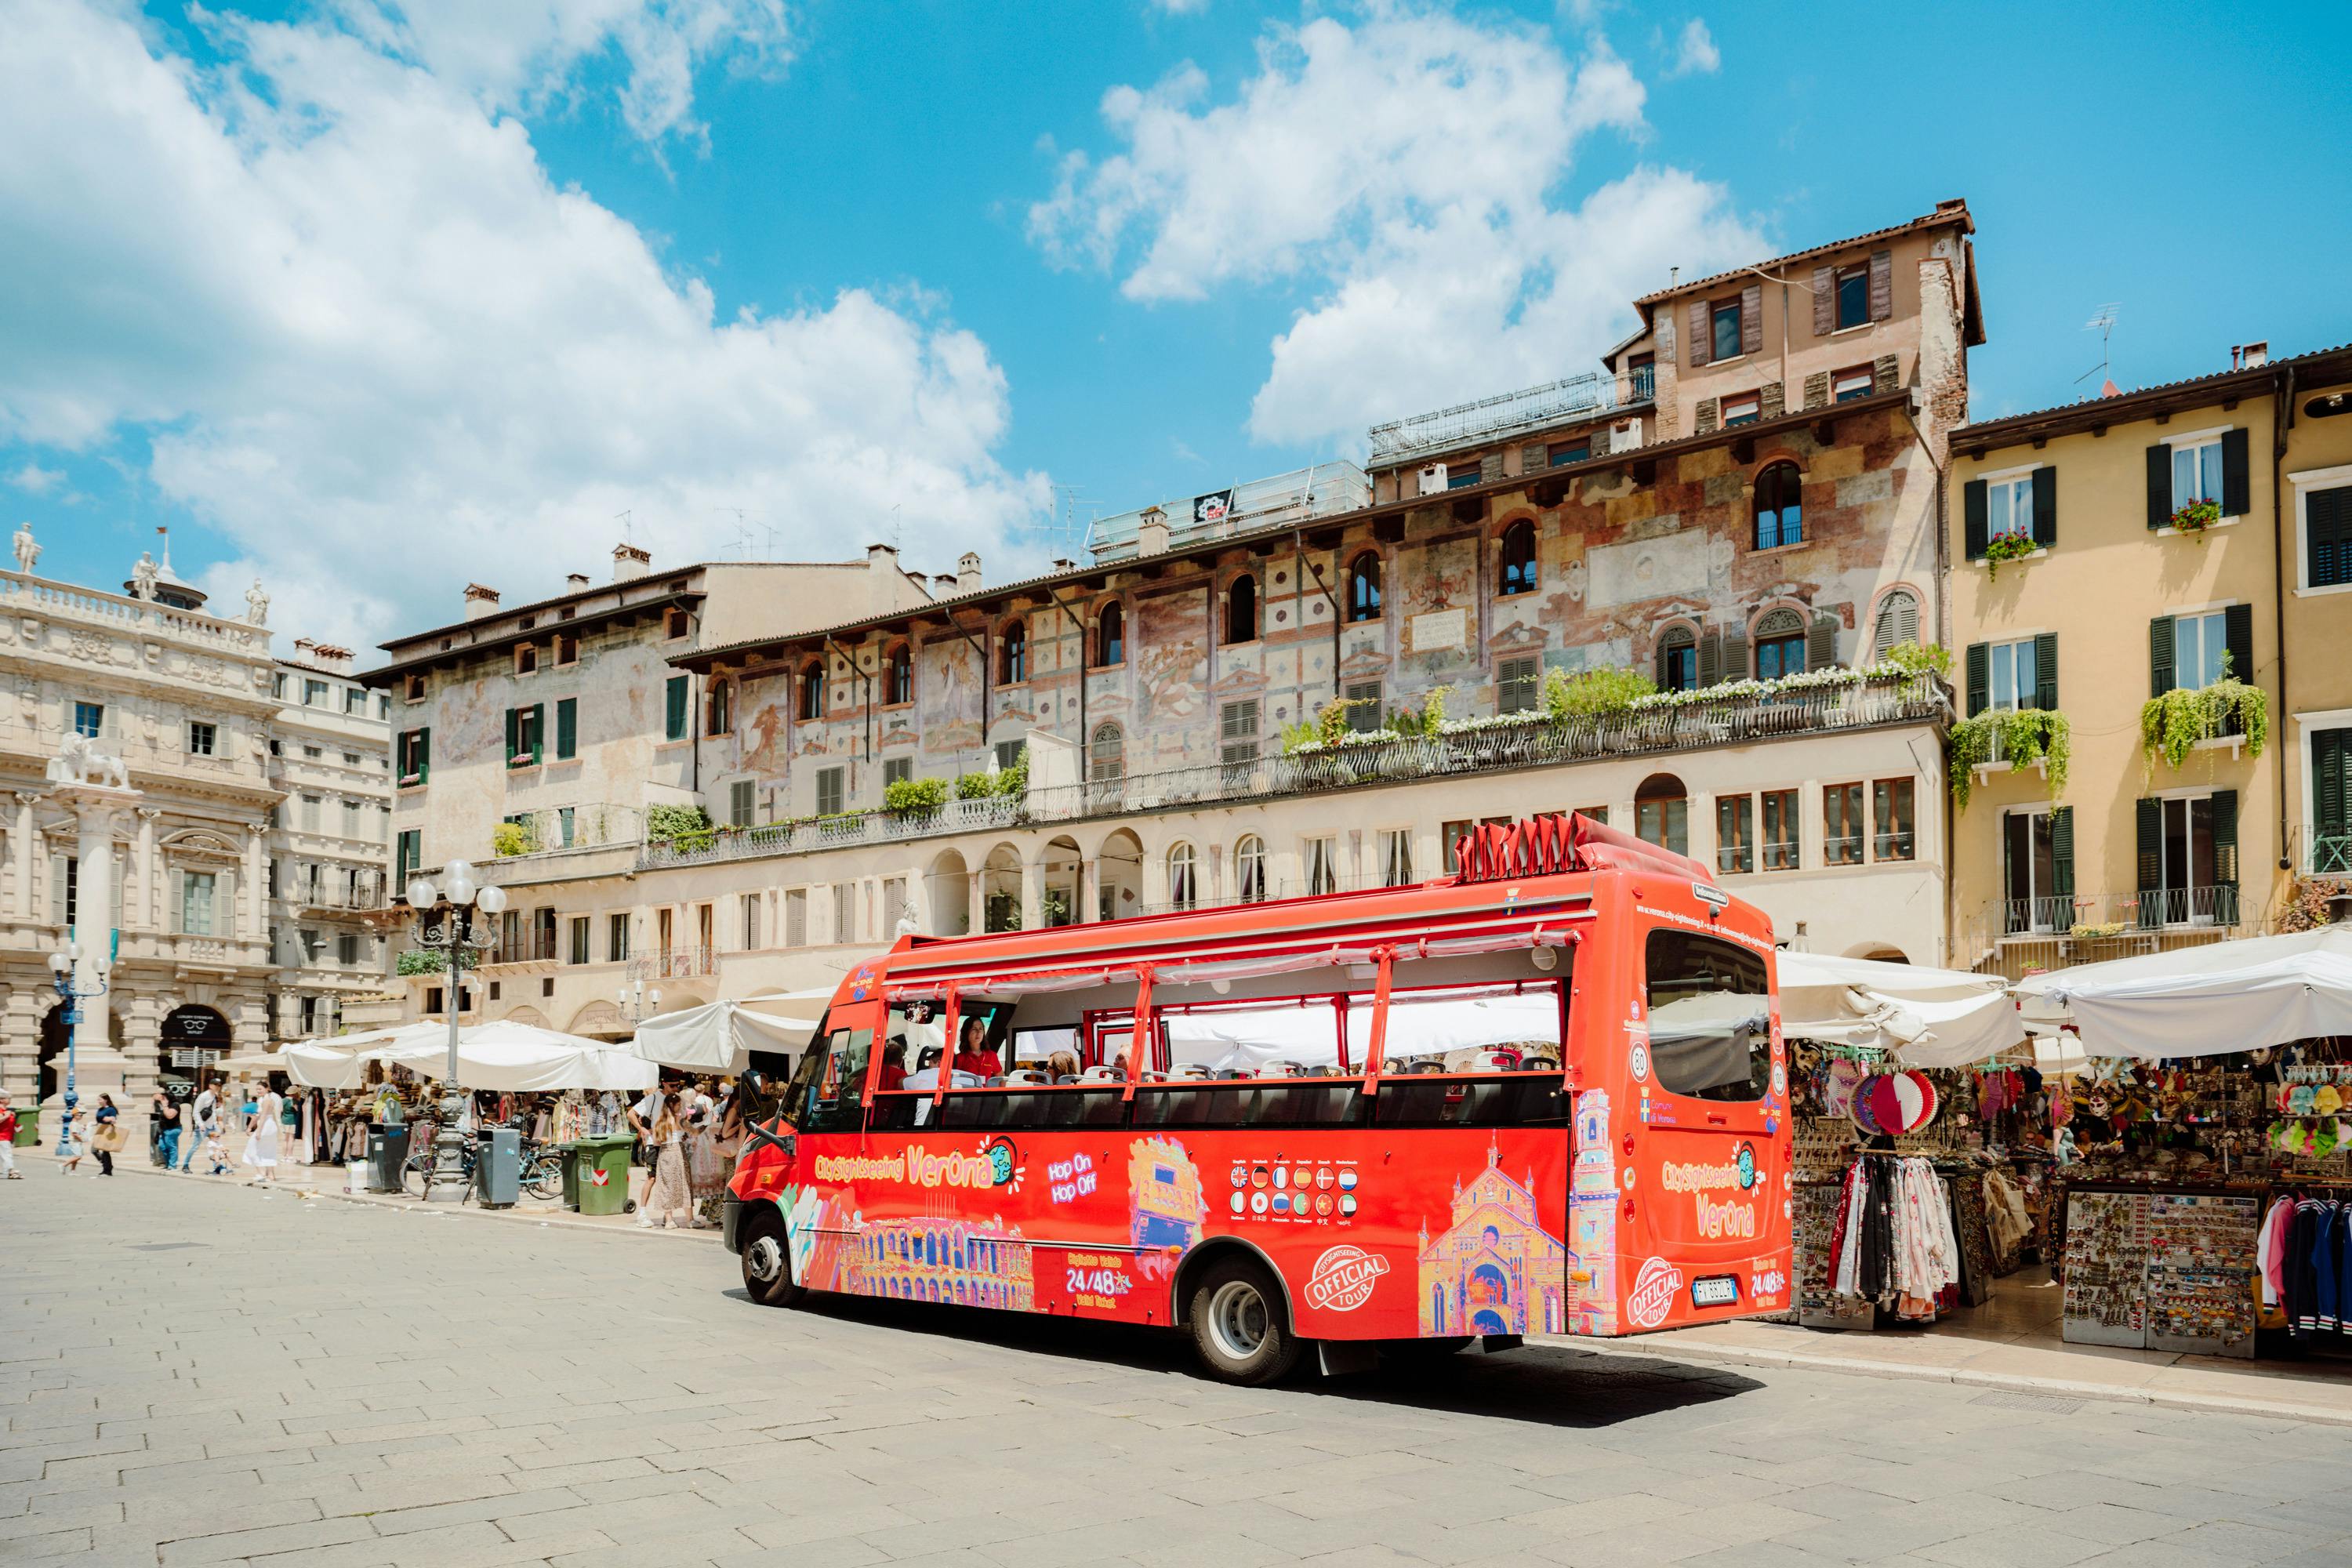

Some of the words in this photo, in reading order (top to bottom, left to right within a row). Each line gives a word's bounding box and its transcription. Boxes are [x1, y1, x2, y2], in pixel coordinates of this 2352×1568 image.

[1635, 1053, 1645, 1071] 80
[1651, 1099, 1672, 1110] Comune
[1658, 1113, 1676, 1123] Verona
[815, 1155, 905, 1183] CitySightseeing
[1047, 1160, 1073, 1182] Hop
[1074, 1152, 1092, 1174] On
[1661, 1160, 1740, 1194] CitySightseeing
[1051, 1183, 1076, 1204] Hop
[1076, 1171, 1097, 1196] Off
[1316, 1218, 1329, 1226] 中文
[1318, 1249, 1361, 1274] CITYSIGHTSEEING
[1313, 1258, 1385, 1301] OFFICIAL
[1338, 1283, 1370, 1305] TOUR
[1633, 1272, 1680, 1316] OFFICIAL
[1648, 1298, 1669, 1322] TOUR
